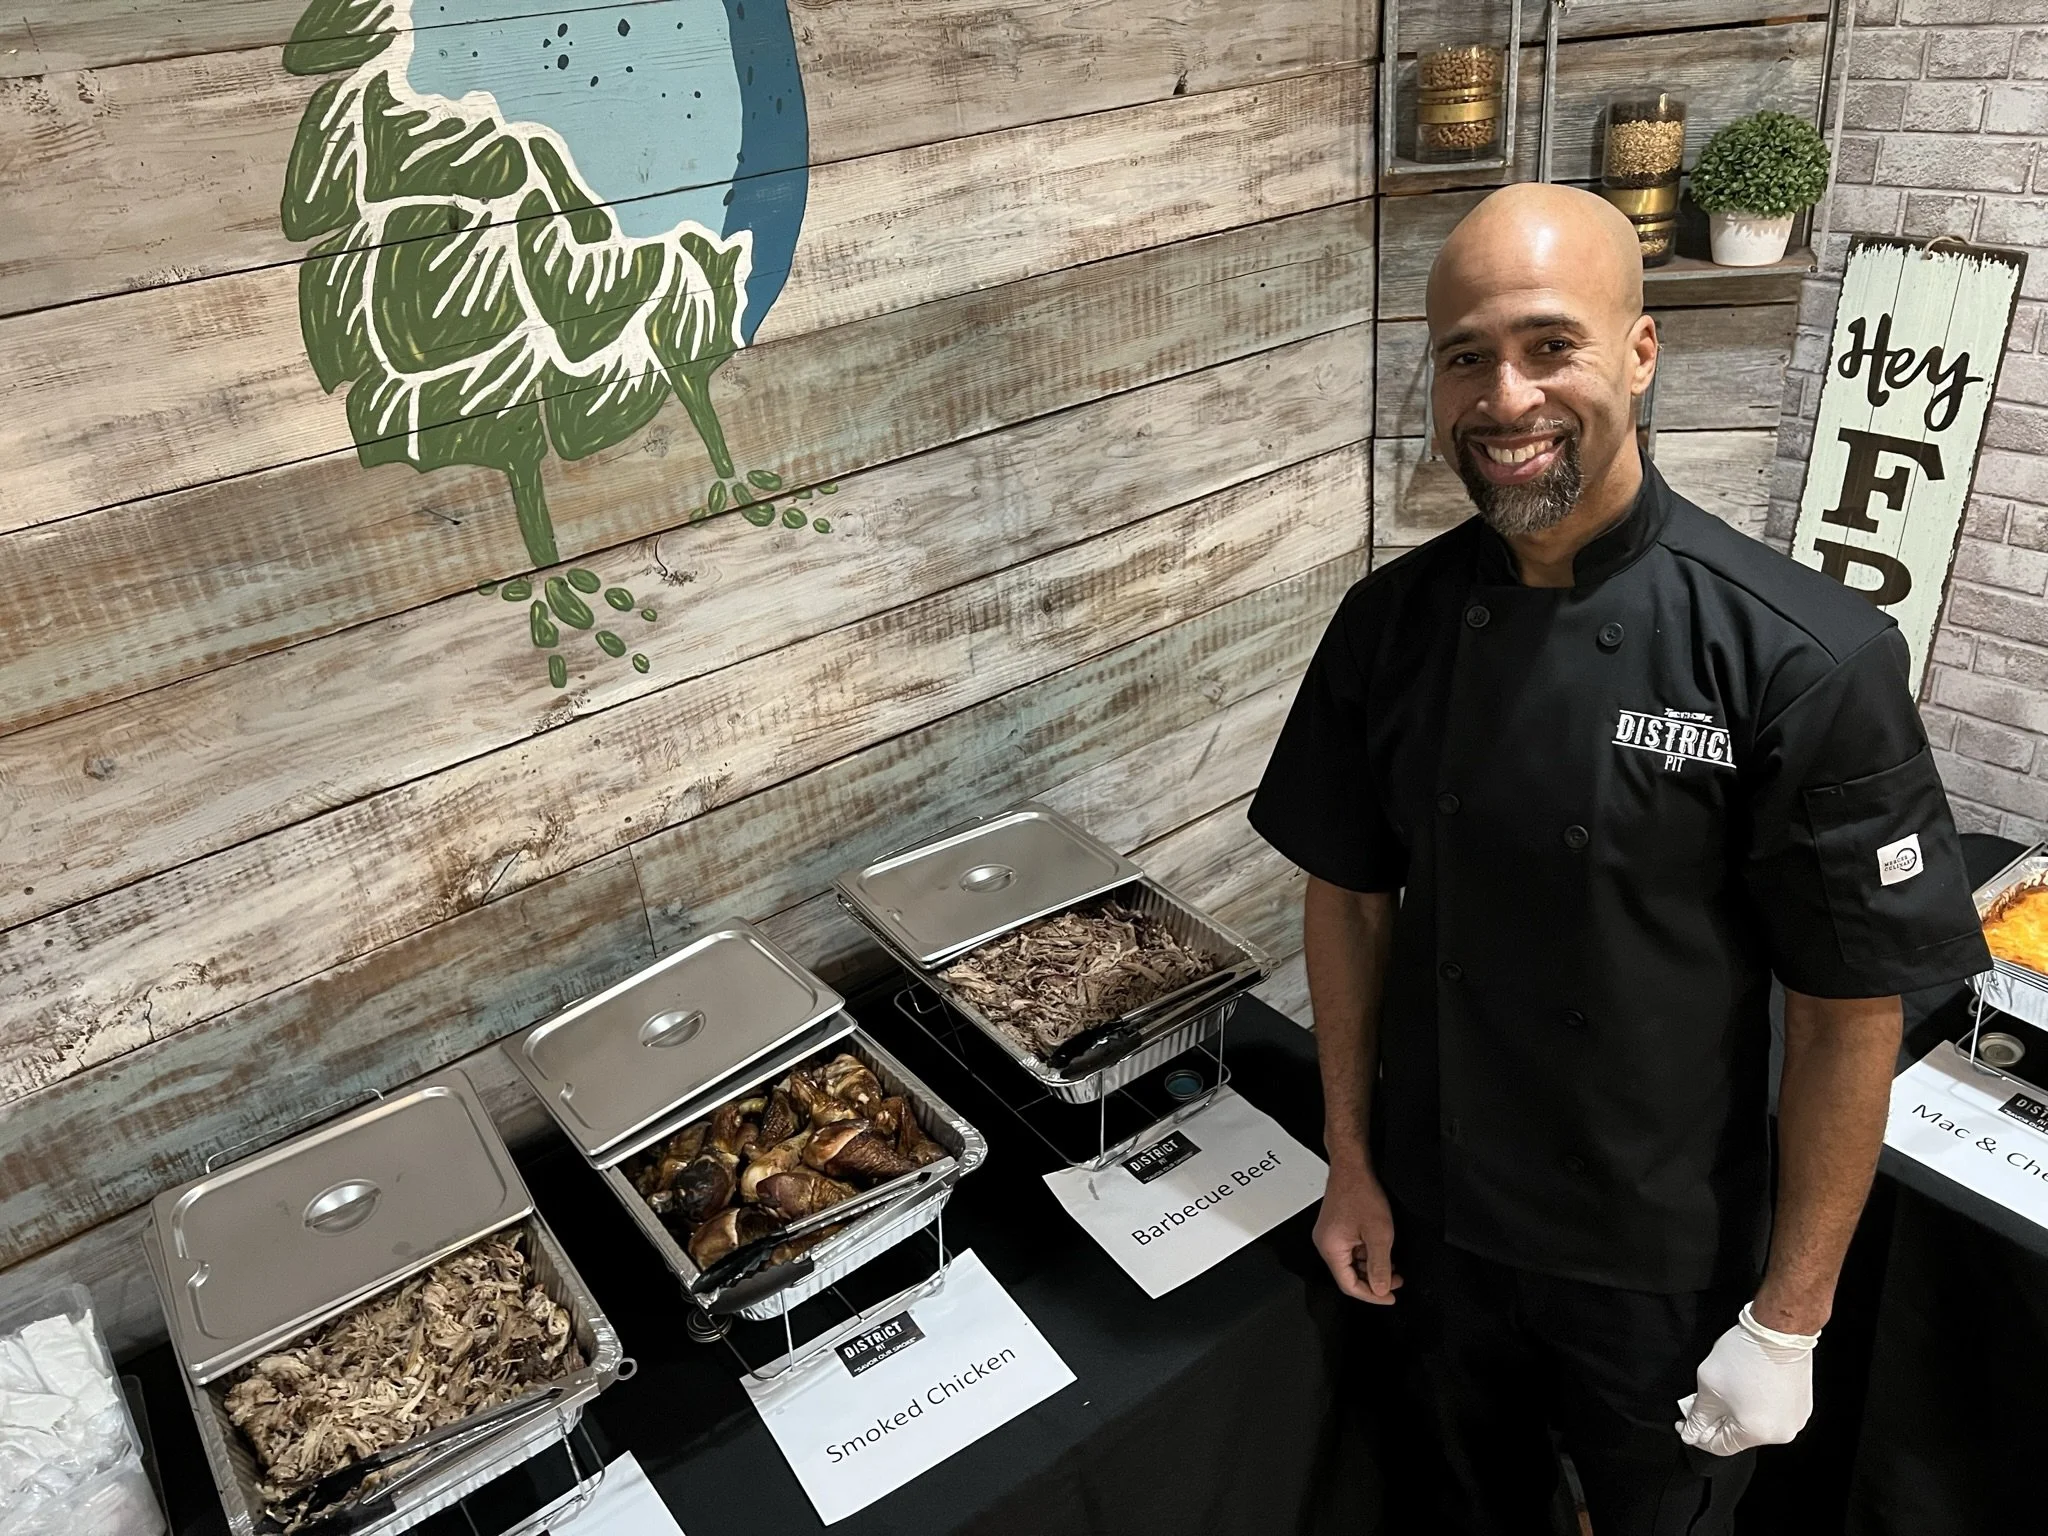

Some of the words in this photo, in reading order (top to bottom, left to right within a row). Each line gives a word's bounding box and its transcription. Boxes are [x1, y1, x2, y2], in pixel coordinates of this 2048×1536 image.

[1837, 312, 1984, 432] Hey
[1664, 755, 1687, 773] PIT
[1912, 1104, 1971, 1139] Mac
[1976, 1137, 1997, 1154] &
[1130, 1140, 1178, 1171] DISTRICT
[1131, 1183, 1234, 1246] Barbecue
[1231, 1150, 1283, 1187] Beef
[843, 1321, 903, 1359] DISTRICT
[826, 1398, 924, 1463] Smoked
[927, 1346, 1016, 1406] Chicken
